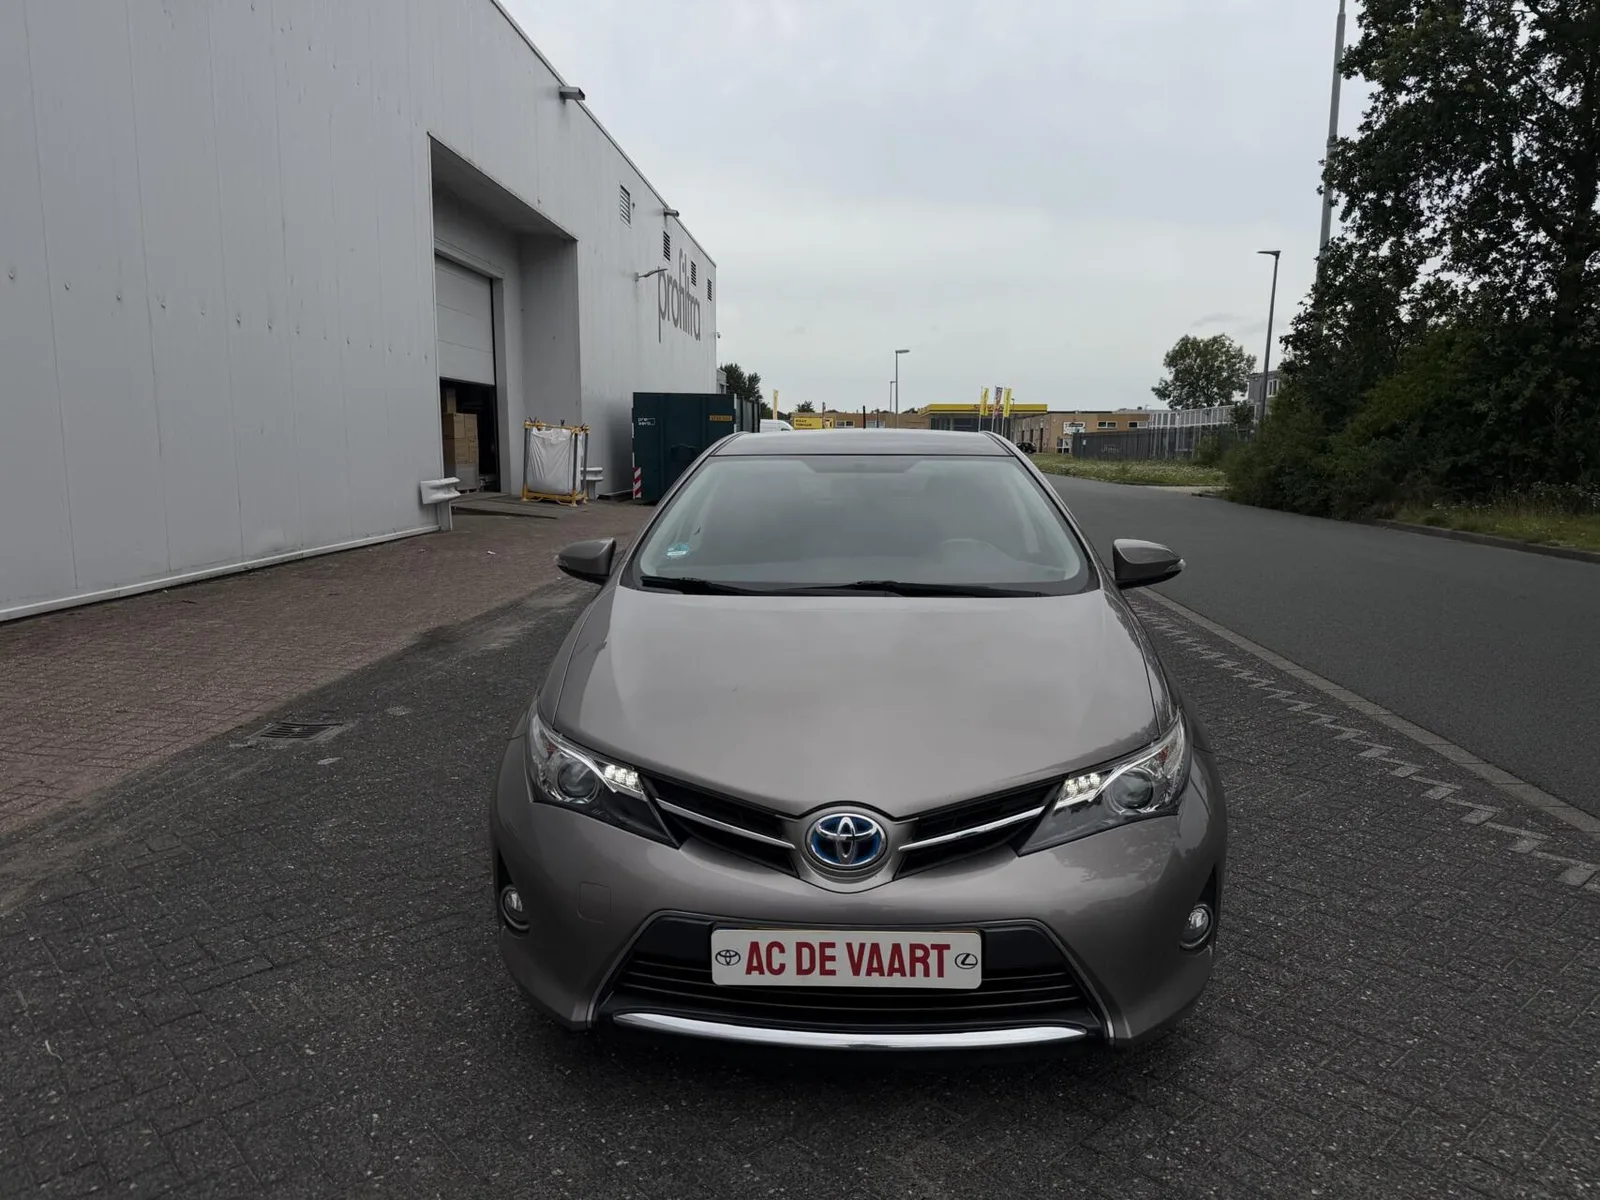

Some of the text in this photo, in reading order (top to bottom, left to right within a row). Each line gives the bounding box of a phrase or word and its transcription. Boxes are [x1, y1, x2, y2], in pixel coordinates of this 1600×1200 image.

[745, 940, 951, 978] AC DE VAART
